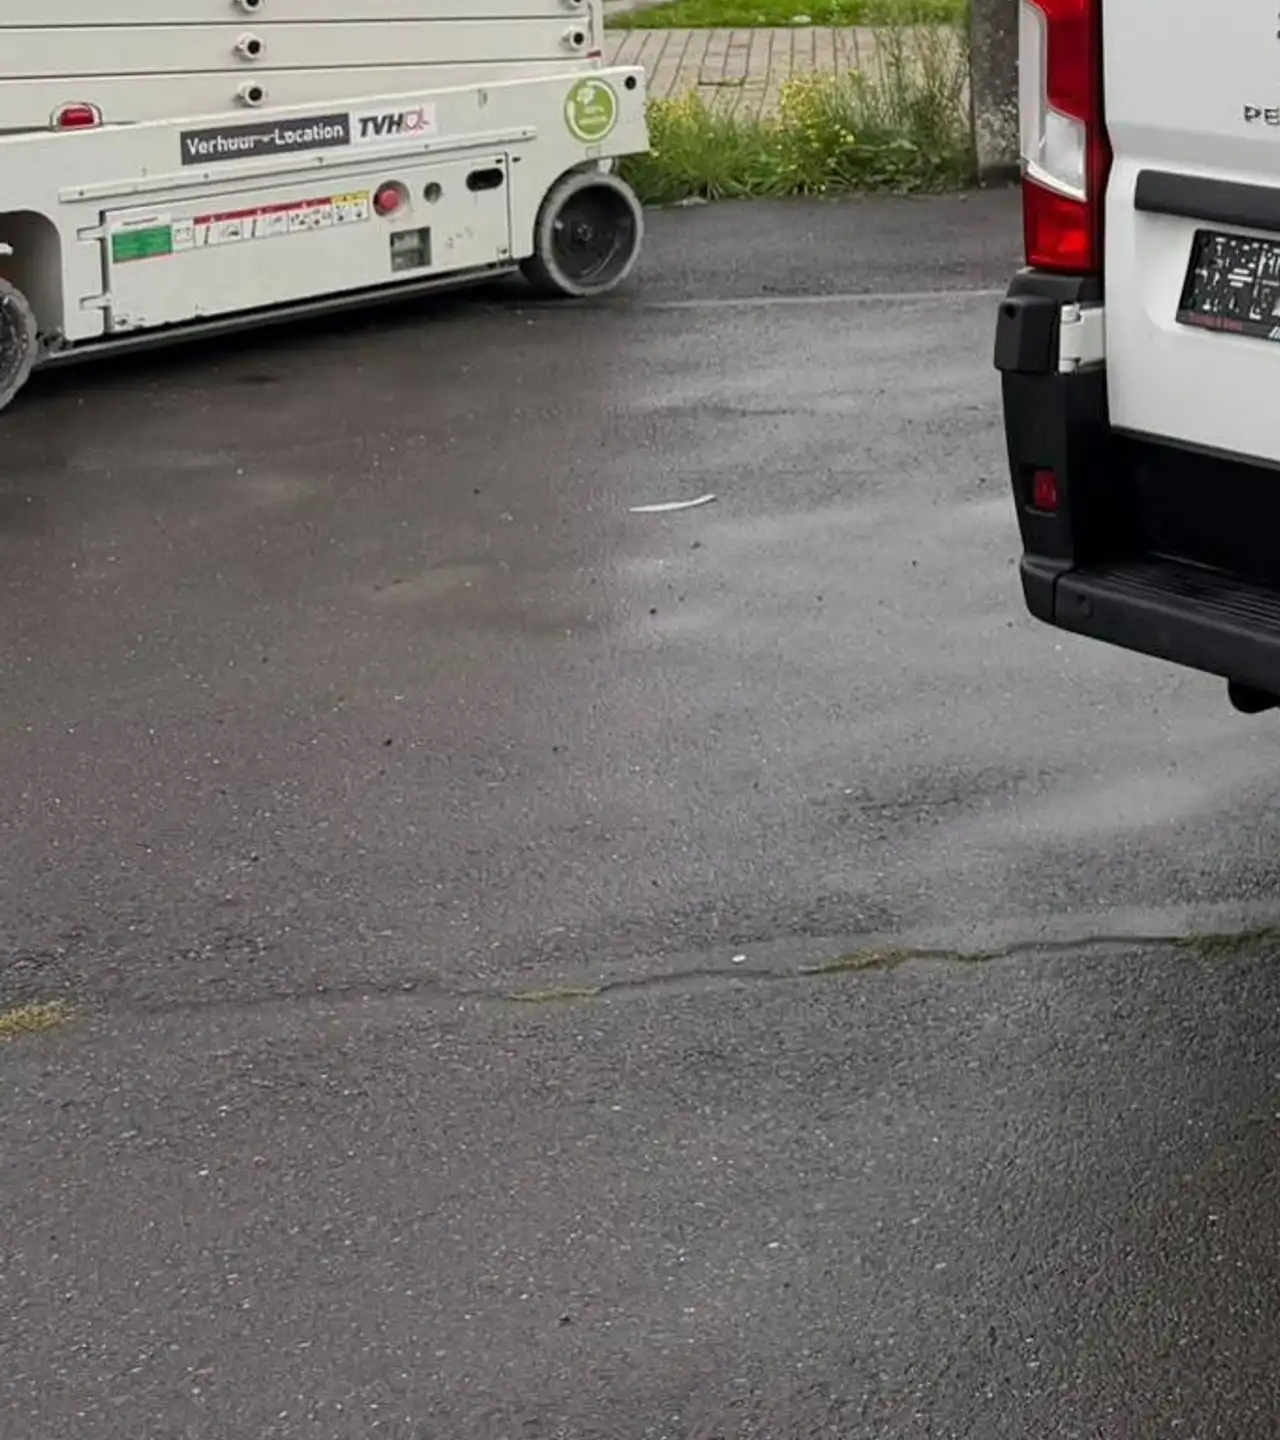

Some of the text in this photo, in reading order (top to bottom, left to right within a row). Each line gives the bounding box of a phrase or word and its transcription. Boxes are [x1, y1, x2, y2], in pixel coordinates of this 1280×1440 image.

[187, 132, 254, 156] Verhuur
[274, 122, 344, 145] Location
[358, 112, 403, 137] TVH
